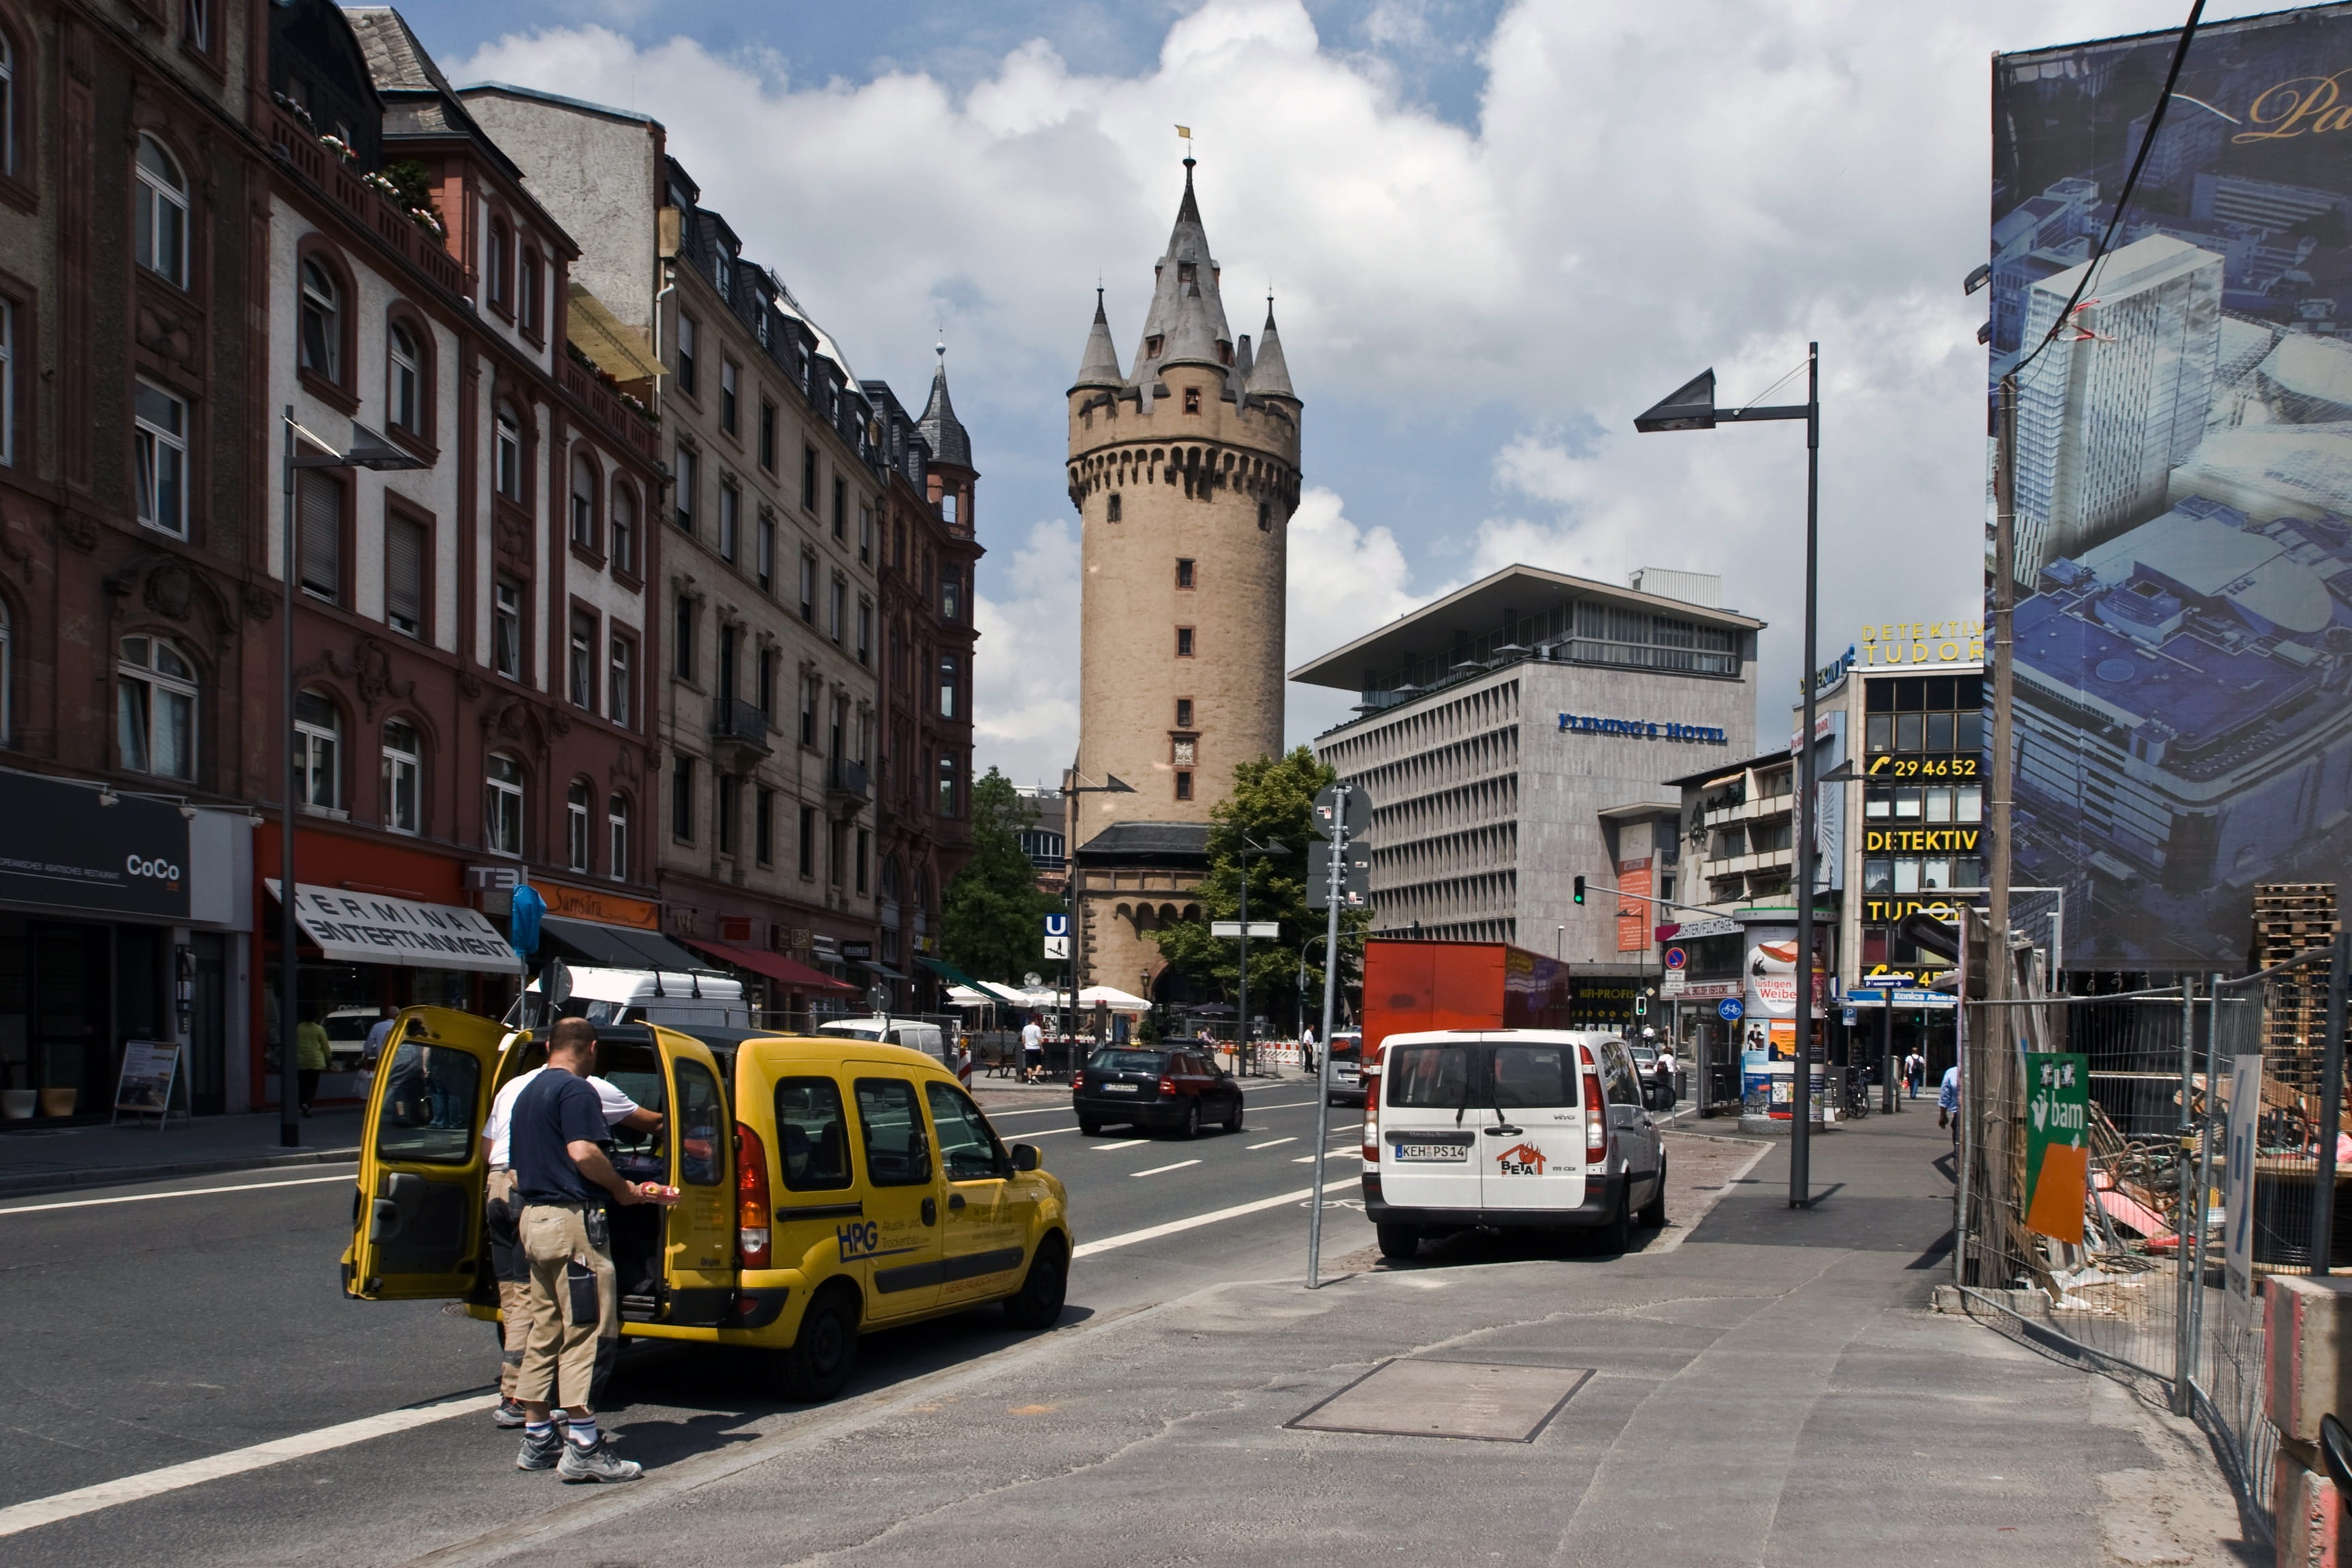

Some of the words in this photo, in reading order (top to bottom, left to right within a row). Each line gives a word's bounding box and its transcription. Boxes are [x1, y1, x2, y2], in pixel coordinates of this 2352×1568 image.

[1862, 620, 1984, 642] DETEKTIV
[1863, 641, 1984, 666] TUDOR
[1559, 713, 1657, 735] FLEMING'S
[1666, 722, 1728, 742] HOTEL
[1894, 761, 1918, 777] 29
[1922, 760, 1948, 776] 46
[1952, 759, 1976, 775] 52
[1867, 830, 1979, 851] DETEKTIV
[127, 854, 180, 881] CoCo
[1046, 916, 1066, 935] U
[1755, 980, 1792, 989] lustigen
[1760, 989, 1797, 999] Weibe
[1894, 992, 1924, 1001] Konica
[1847, 1008, 1854, 1017] P
[2051, 1090, 2083, 1130] bam
[1403, 1145, 1426, 1157] KEH
[1501, 1160, 1534, 1175] BETA
[837, 1221, 878, 1254] HPG
